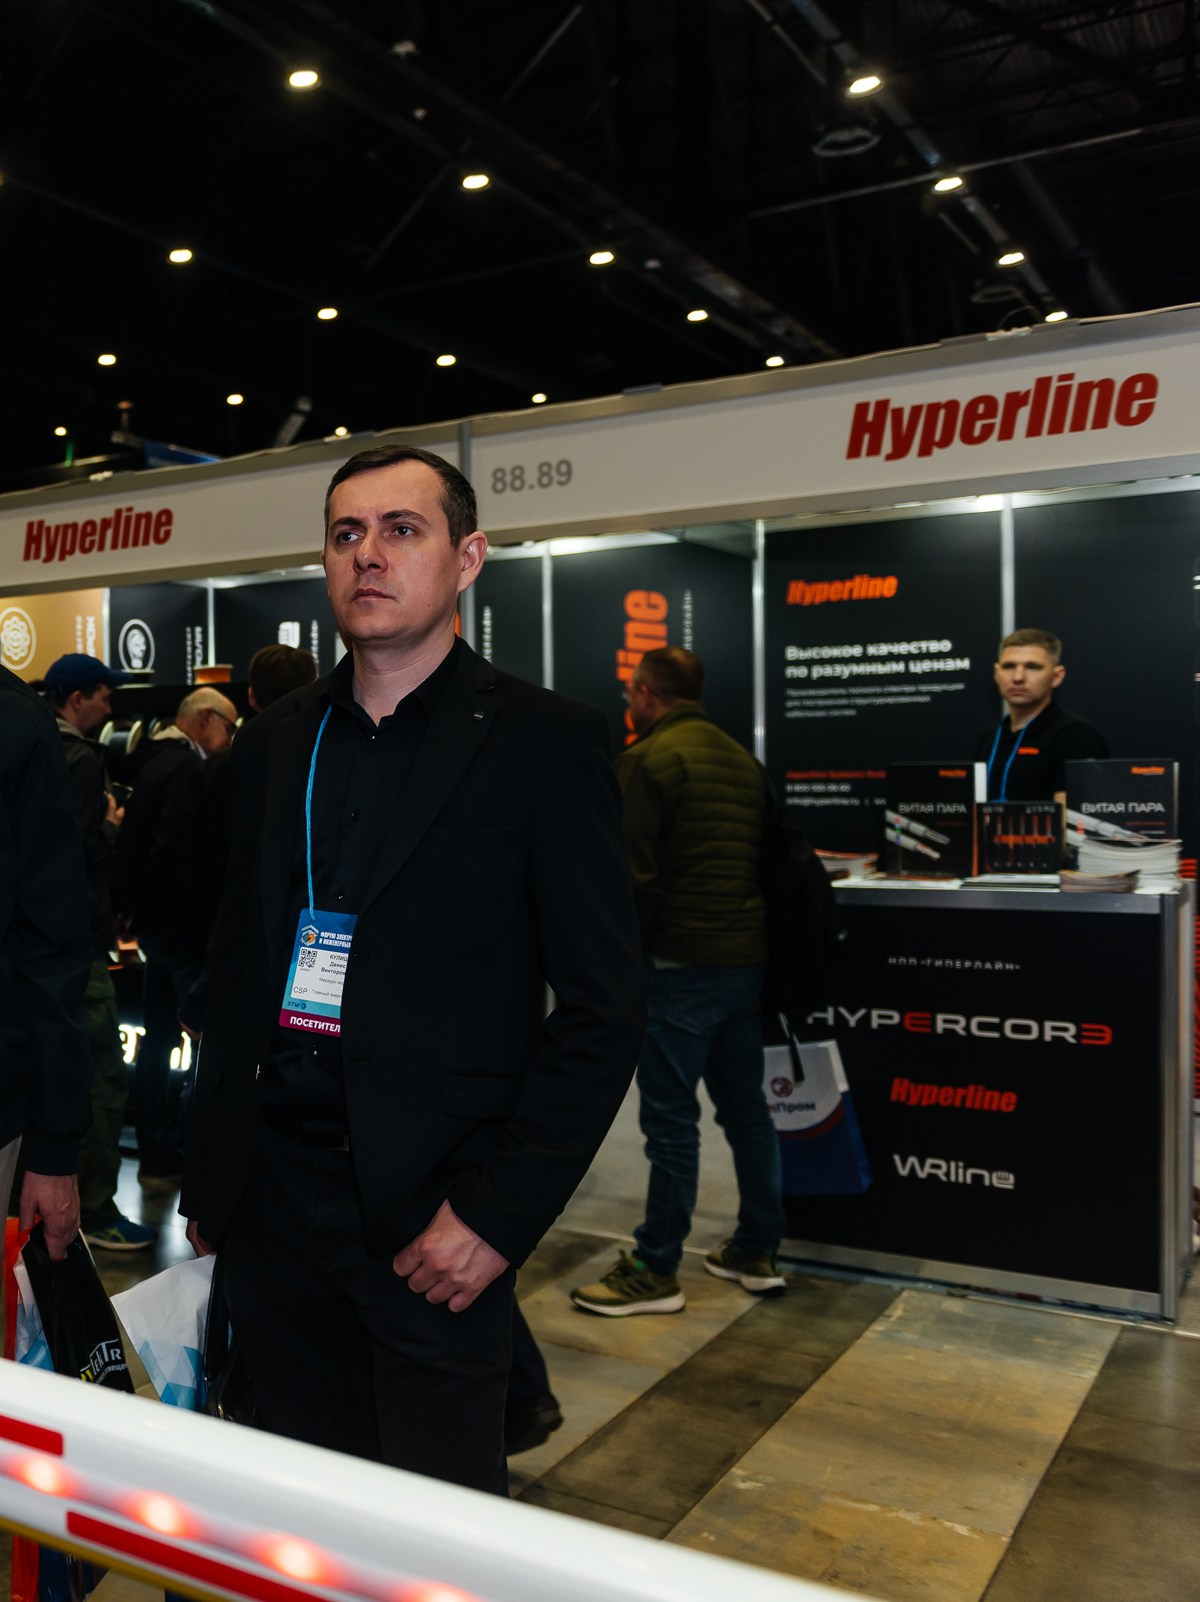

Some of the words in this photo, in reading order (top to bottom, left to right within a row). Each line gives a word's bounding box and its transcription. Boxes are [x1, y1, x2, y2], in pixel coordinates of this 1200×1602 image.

[845, 372, 1159, 461] Hyperline
[492, 459, 573, 494] 88.89
[23, 506, 173, 563] Hyperline
[786, 575, 898, 605] Hyperline
[785, 644, 863, 661] Высокое
[866, 639, 952, 656] качество
[785, 665, 808, 679] по
[811, 660, 905, 680] разумным
[908, 657, 970, 674] ценам
[899, 803, 934, 814] ВИТАЯ
[936, 803, 967, 813] ПАРА
[1081, 802, 1126, 814] ВИТАЯ
[1128, 802, 1165, 813] ПАРА
[329, 961, 346, 969] Денис
[293, 986, 308, 994] CSP
[890, 1077, 1018, 1113] Hyperline
[893, 1153, 1015, 1189] WRline
